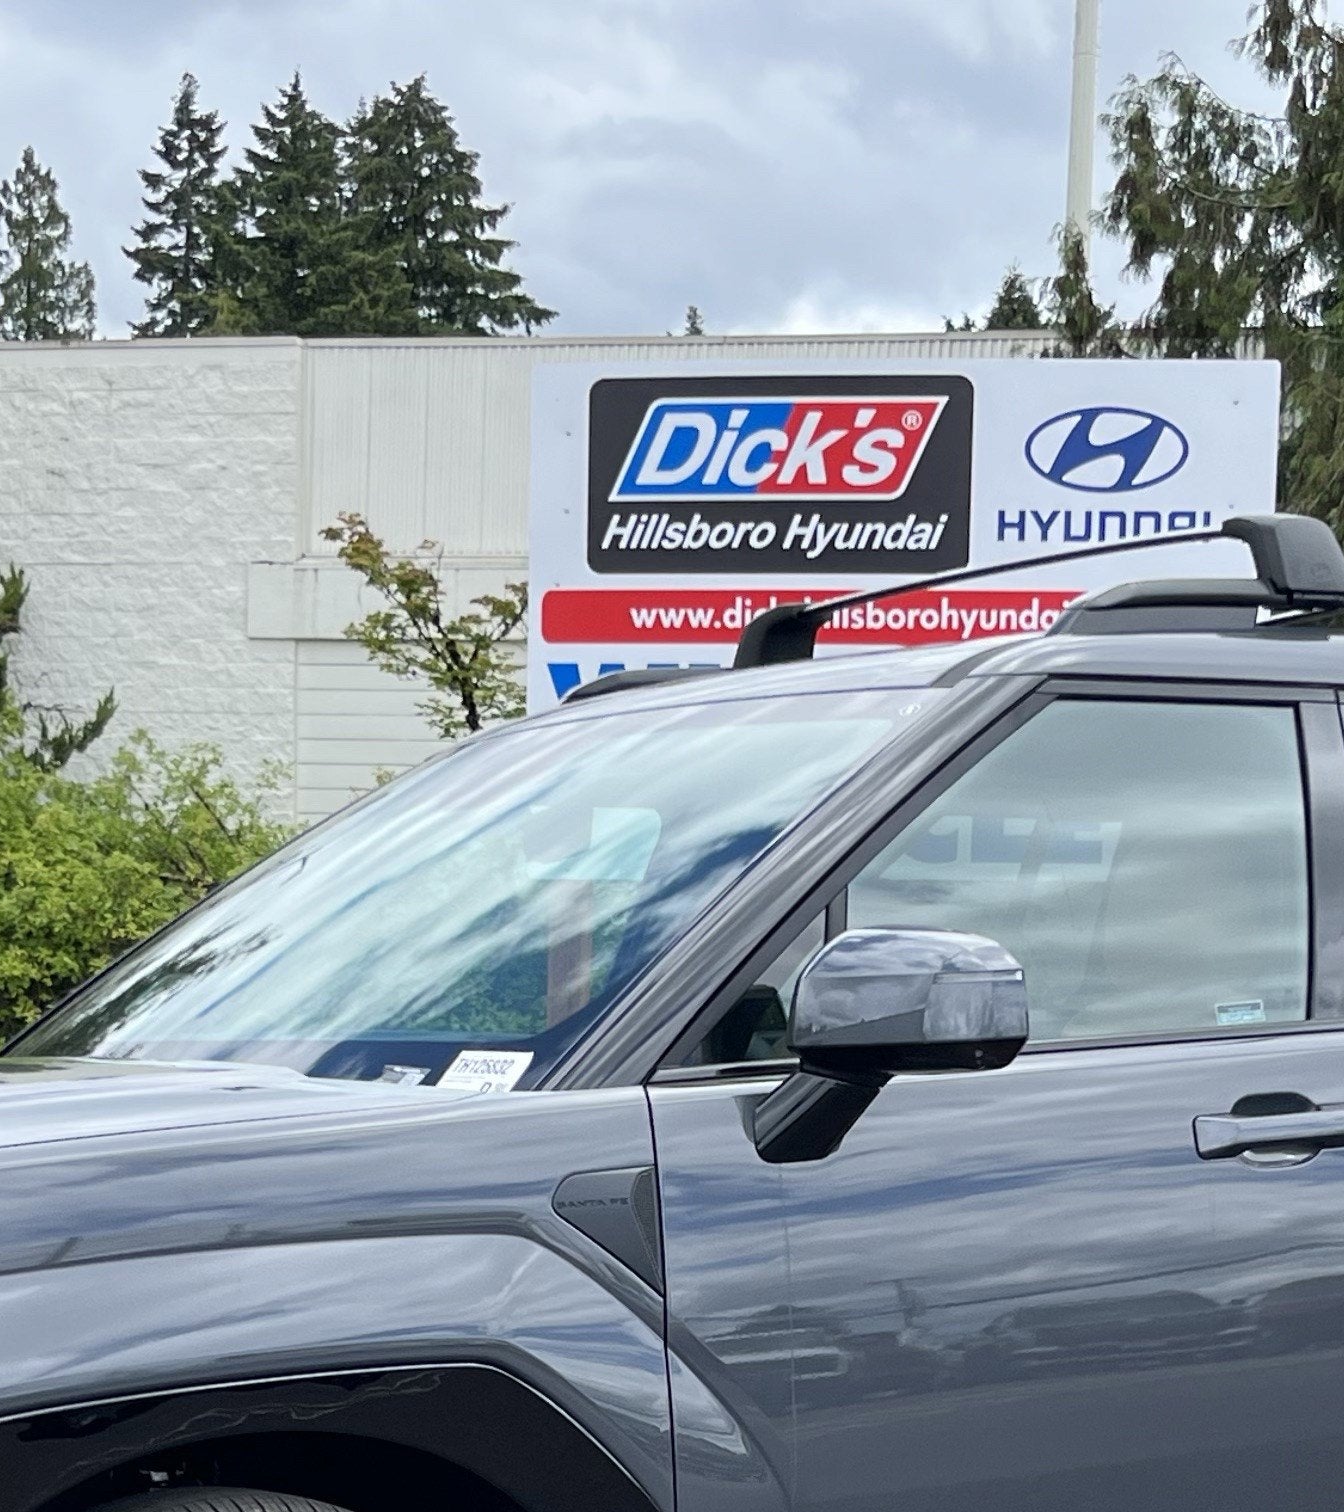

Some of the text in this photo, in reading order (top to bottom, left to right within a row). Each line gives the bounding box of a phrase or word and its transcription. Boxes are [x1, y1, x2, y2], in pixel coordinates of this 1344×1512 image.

[635, 408, 905, 488] Dick's
[601, 513, 949, 559] Hillsboro Hyundai
